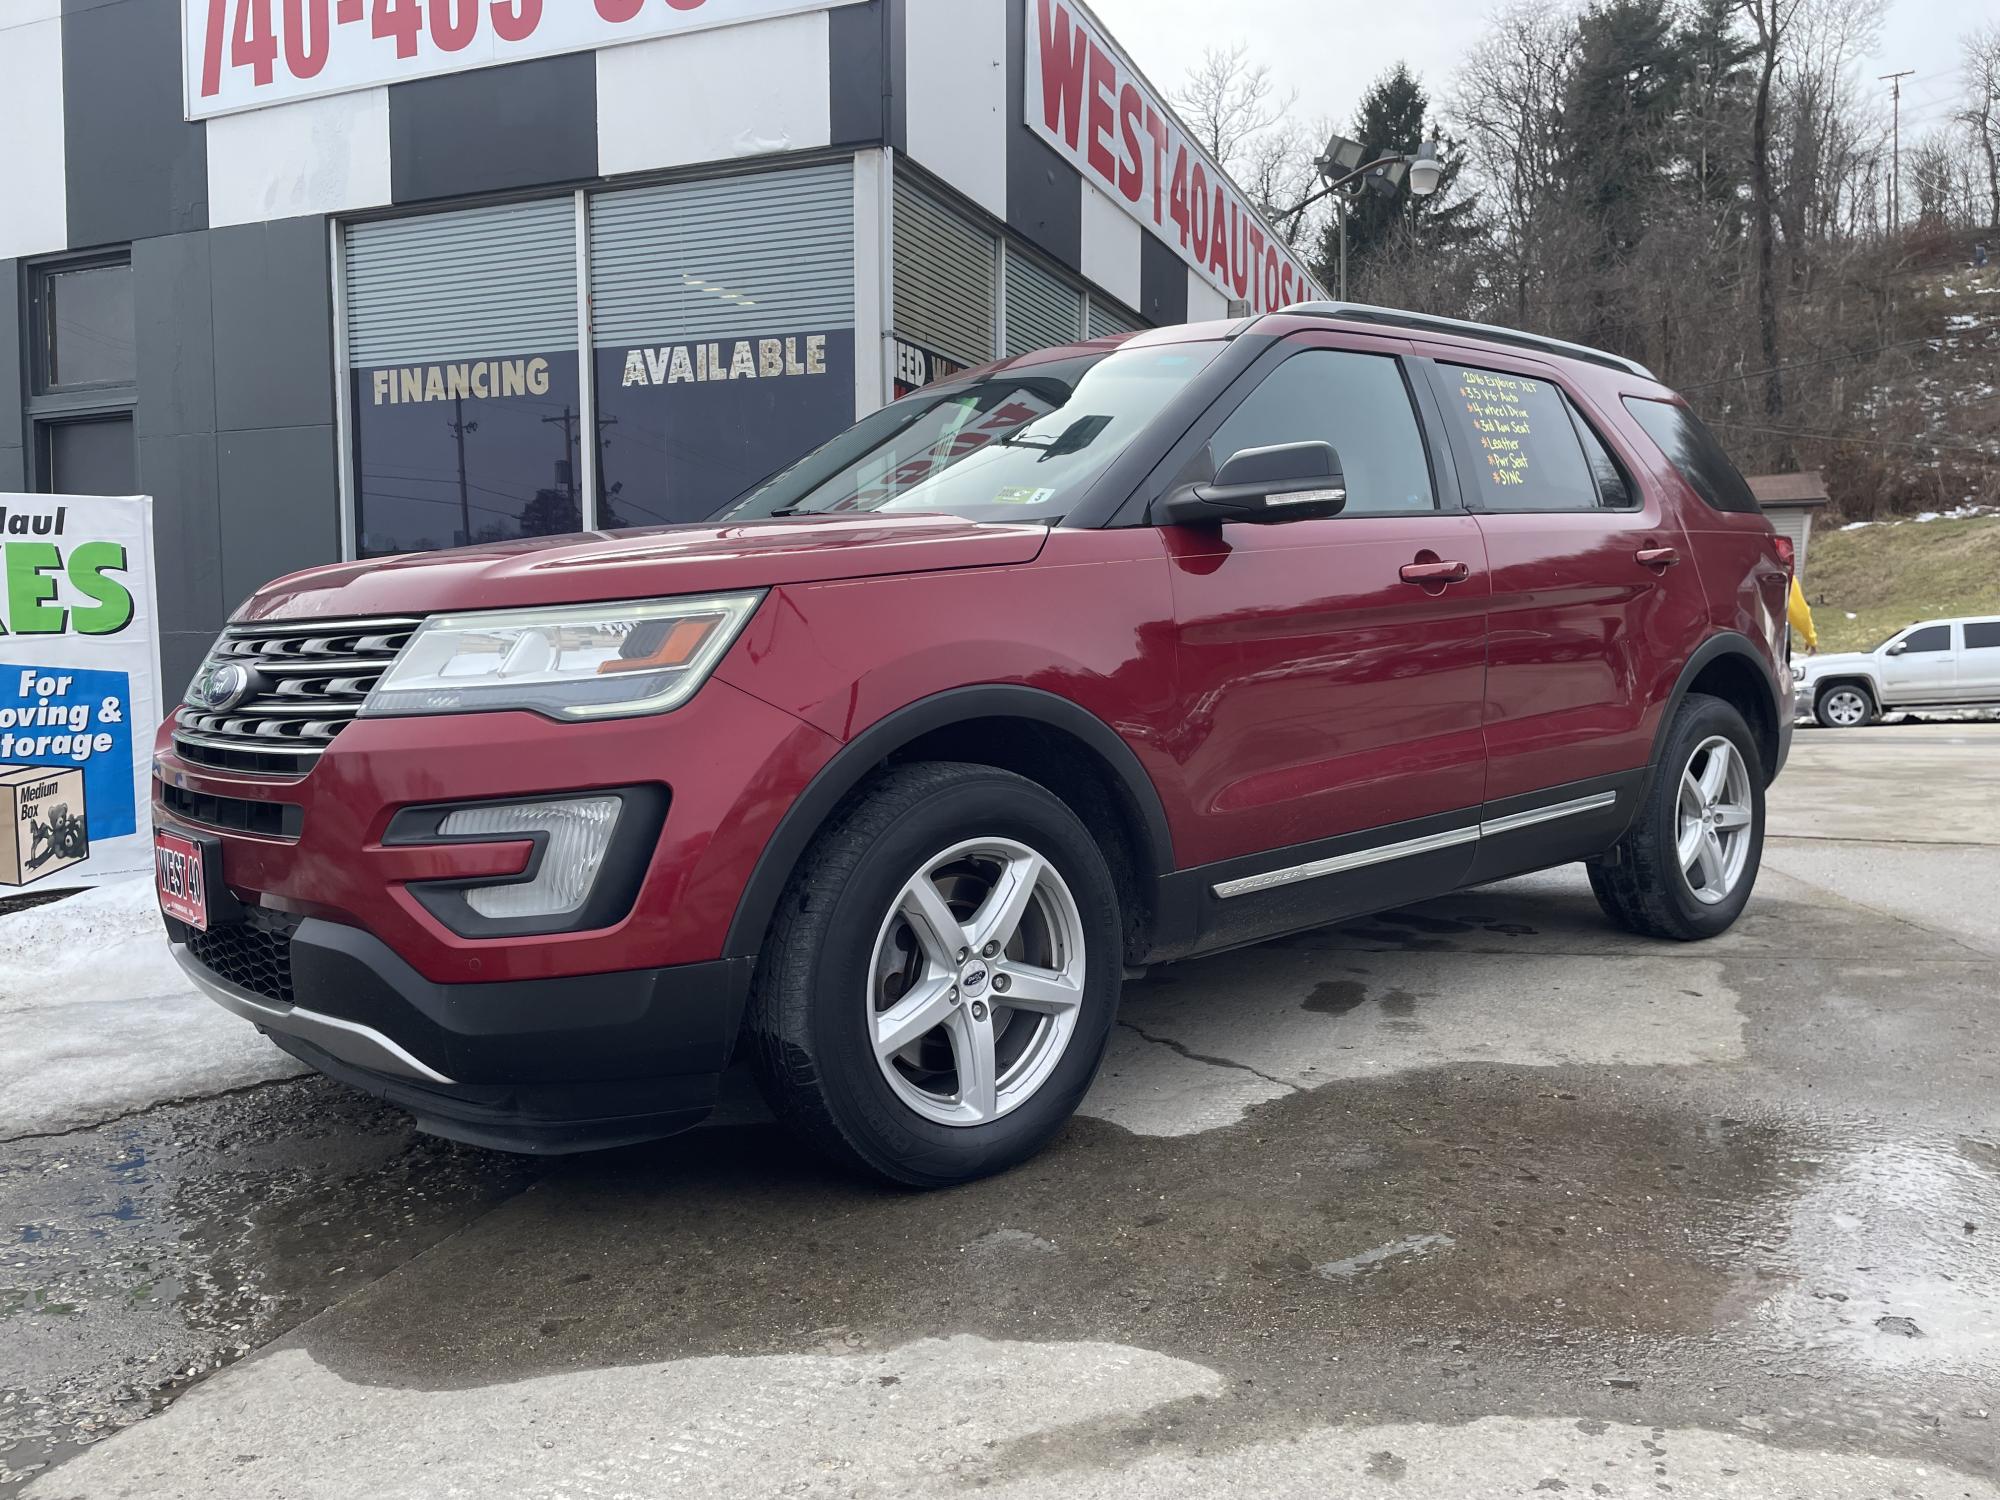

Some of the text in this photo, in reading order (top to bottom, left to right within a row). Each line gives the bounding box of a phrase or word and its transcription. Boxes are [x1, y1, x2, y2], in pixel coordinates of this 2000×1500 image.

[373, 335, 826, 405] FINANCING AVAILABLE
[894, 341, 926, 387] EED
[1465, 387, 1481, 399] 3.5
[1519, 380, 1537, 393] XLT
[1486, 436, 1519, 450] Leather
[0, 541, 134, 636] ES
[19, 670, 73, 697] For
[0, 696, 122, 732] oving &
[0, 733, 113, 761] torage
[20, 781, 58, 804] Medium
[20, 804, 39, 821] Box
[157, 846, 202, 907] WEST 40
